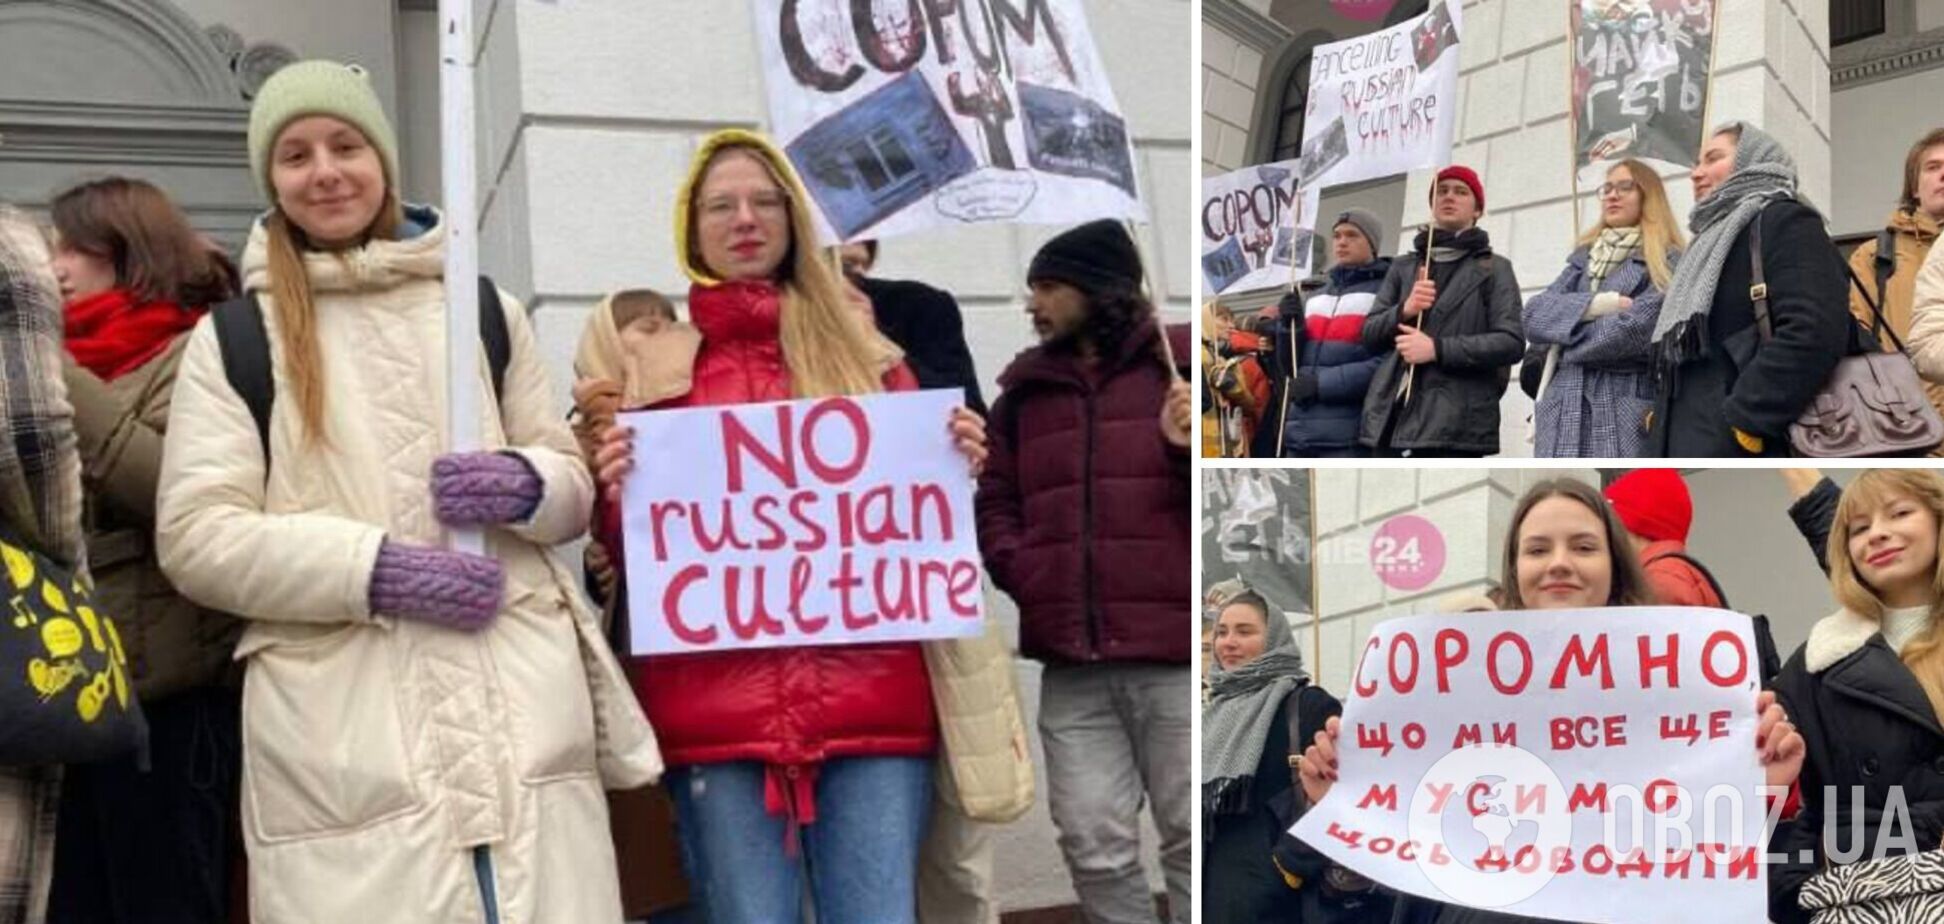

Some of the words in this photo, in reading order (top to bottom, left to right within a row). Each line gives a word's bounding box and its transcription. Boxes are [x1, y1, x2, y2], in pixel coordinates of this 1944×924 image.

[720, 396, 871, 492] NO
[650, 483, 953, 561] russian
[662, 551, 979, 644] culture
[1355, 628, 1756, 698] СОРОМНО,
[1357, 721, 1426, 756] ЩО
[1452, 722, 1517, 749] МИ
[1550, 715, 1628, 751] ВСЕ
[1659, 710, 1732, 746] ЩЕ
[1356, 779, 1679, 817] МУСИМО
[1325, 822, 1451, 866] ЩОСЬ
[1474, 842, 1759, 880] ДОВОДИТИ
